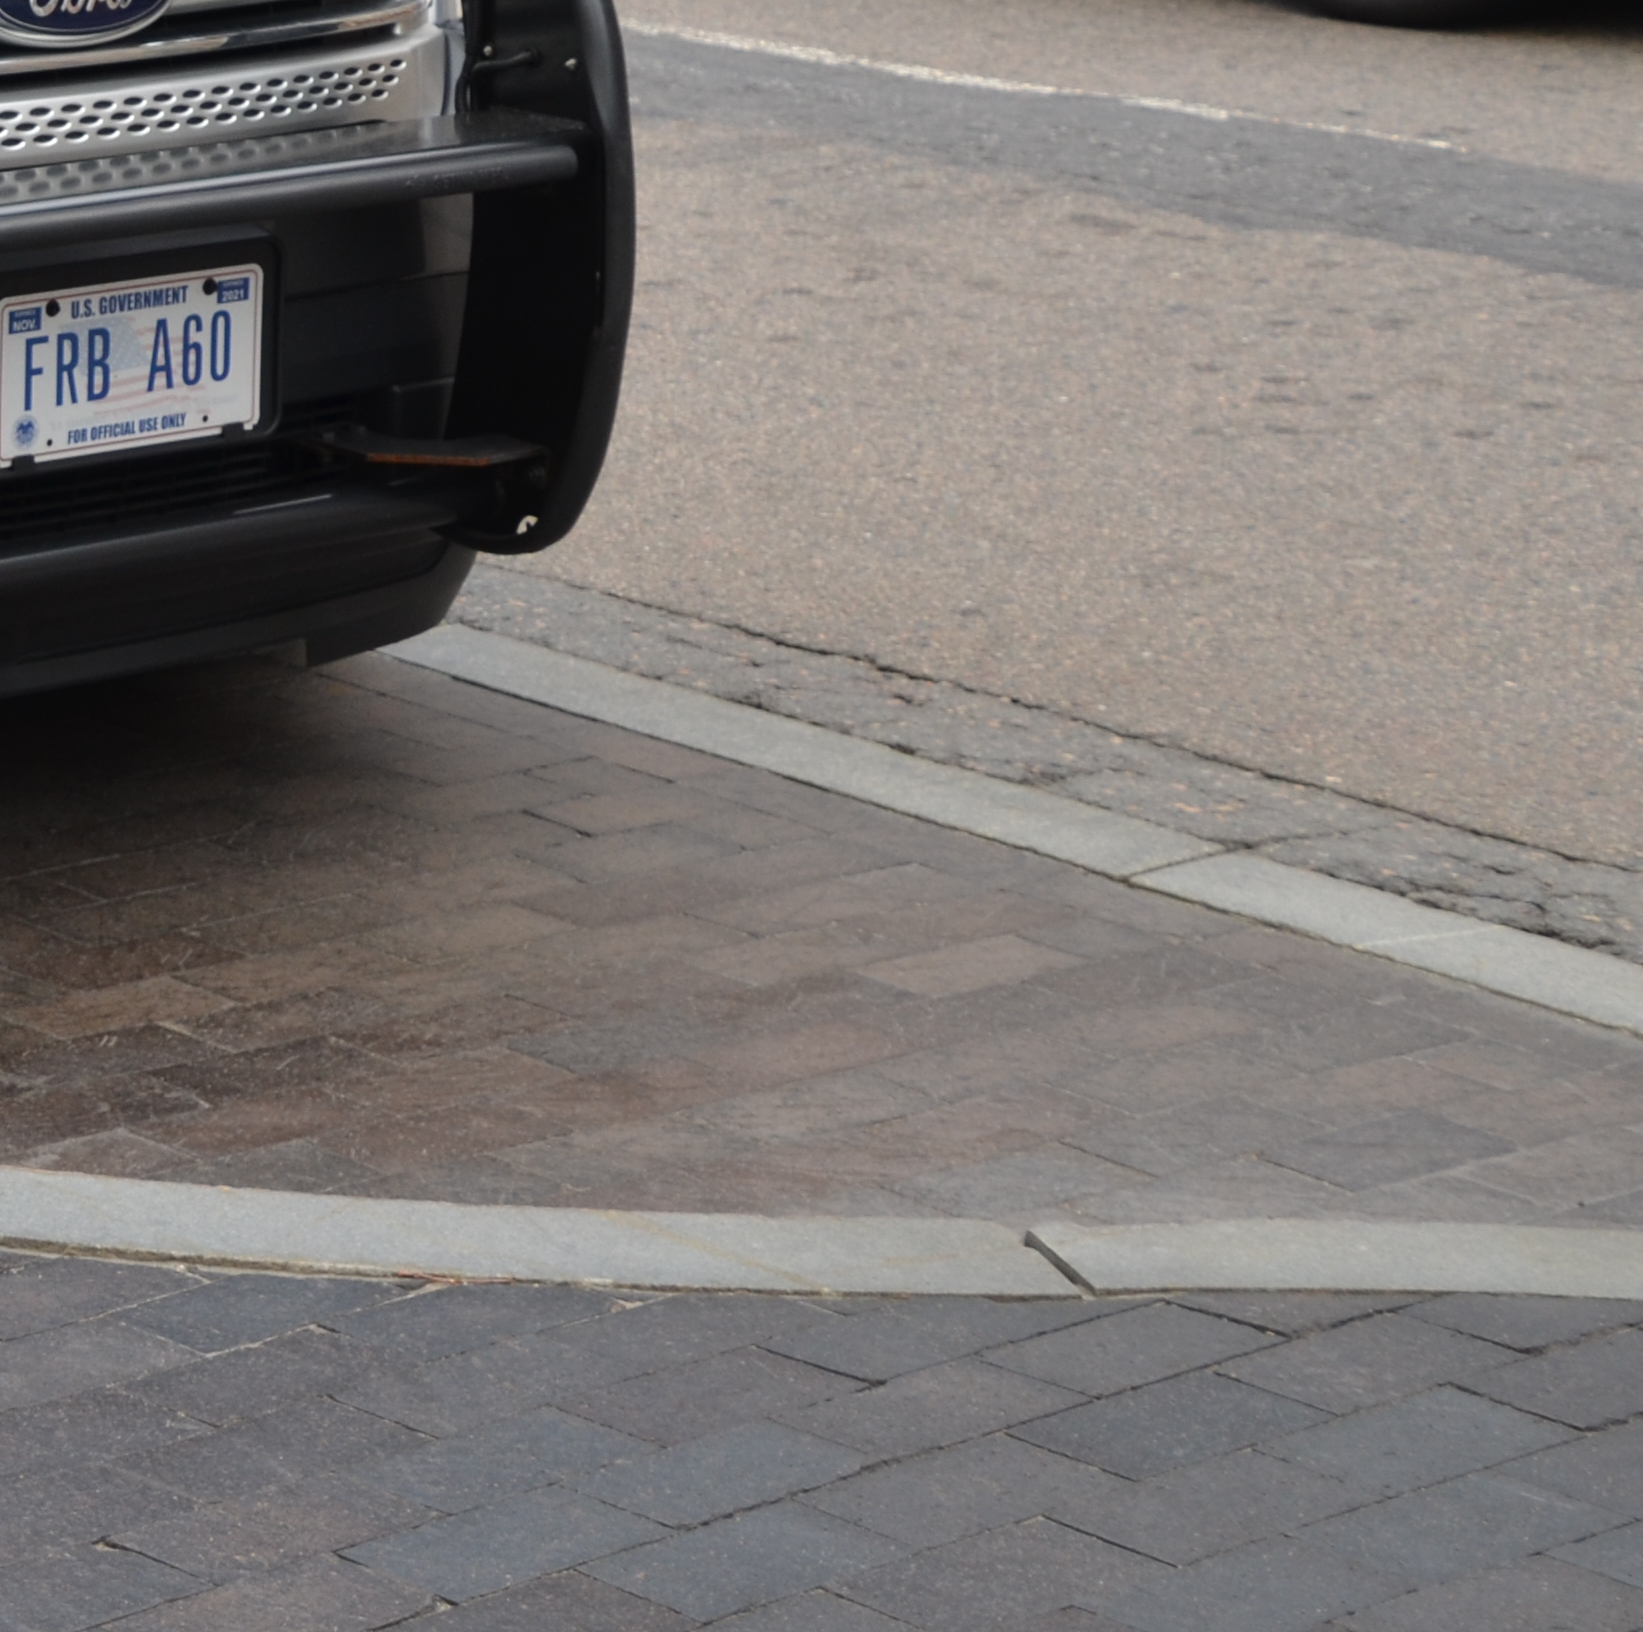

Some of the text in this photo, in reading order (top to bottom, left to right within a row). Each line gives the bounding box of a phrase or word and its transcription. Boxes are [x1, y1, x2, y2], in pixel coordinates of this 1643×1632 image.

[71, 285, 189, 319] U.S. GOVERNMENT
[222, 288, 244, 302] 2021
[24, 309, 232, 411] FRB A60
[67, 412, 187, 445] FOR OFFICIAL USE ONLY
